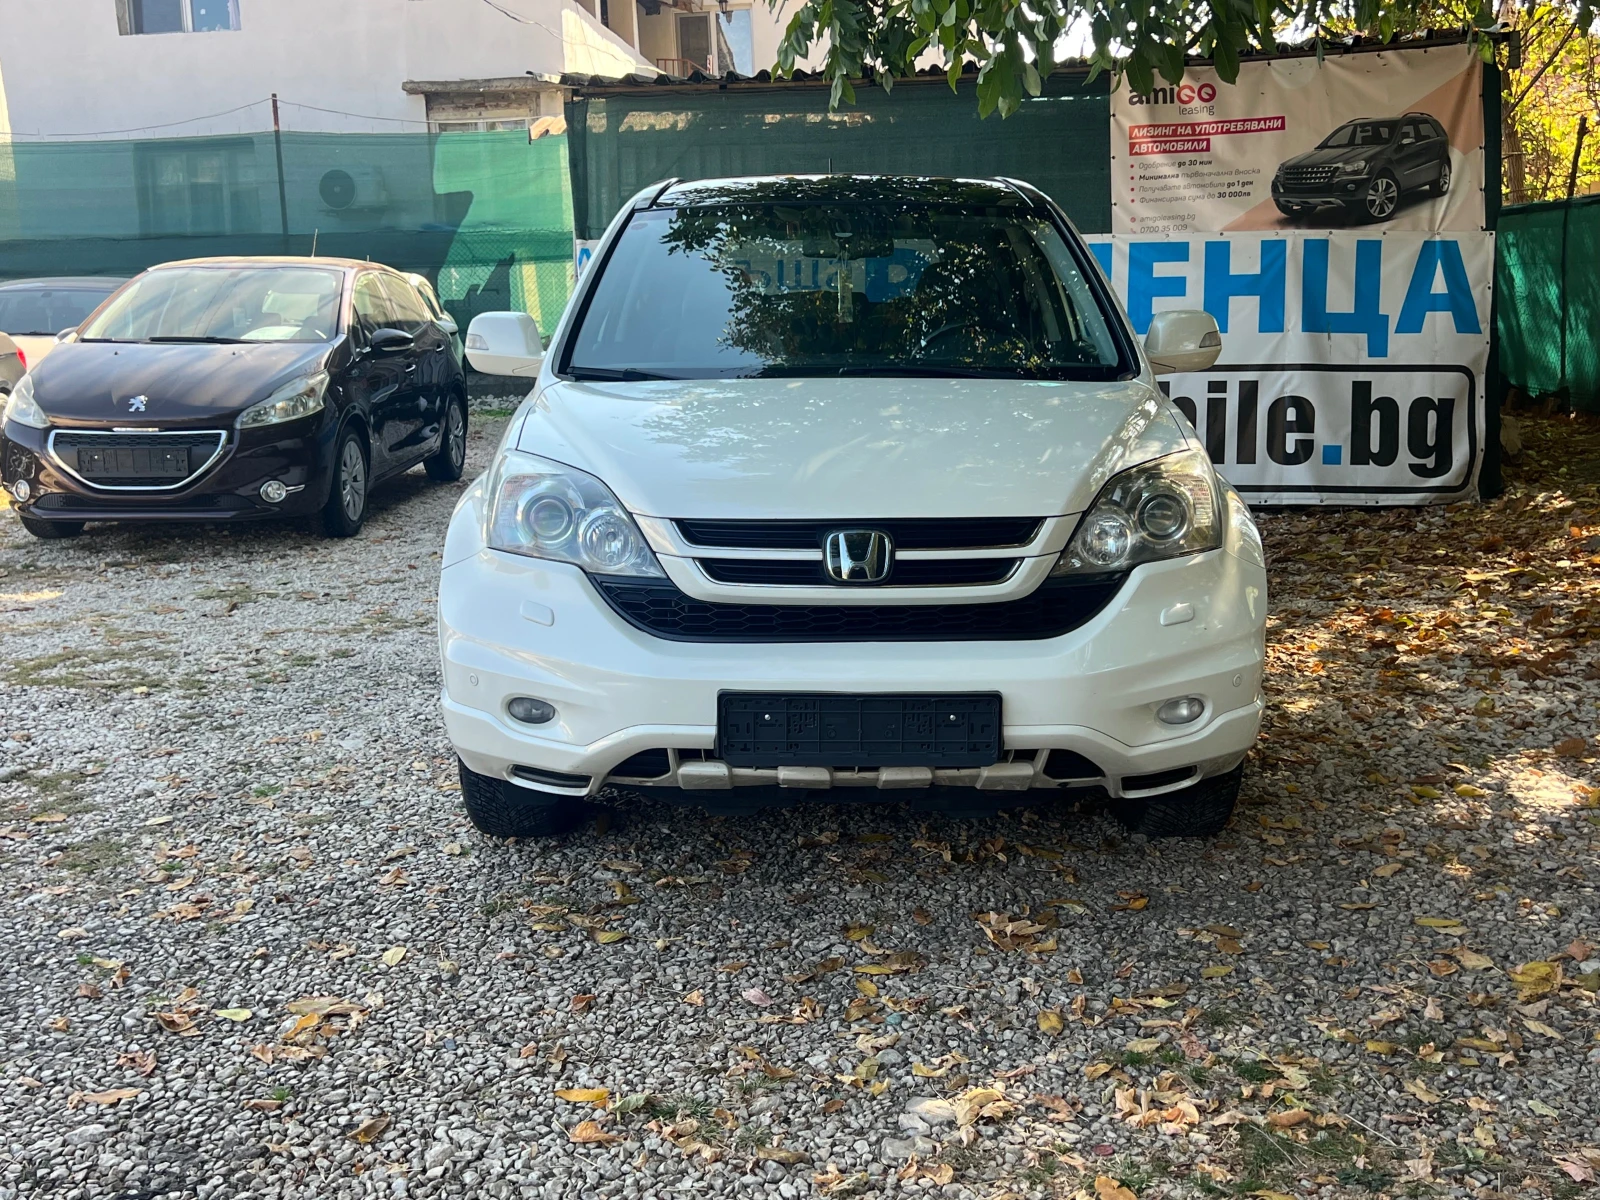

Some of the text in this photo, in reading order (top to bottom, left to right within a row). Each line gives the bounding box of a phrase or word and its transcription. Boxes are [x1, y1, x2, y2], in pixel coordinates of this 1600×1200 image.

[1178, 105, 1215, 116] leasing
[1131, 119, 1282, 138] ЛИЗИНГ НА УПОТРЕБЯВАНИ
[1131, 141, 1207, 154] АВТОМОБИЛИ
[1138, 173, 1179, 181] Минимална
[1217, 191, 1227, 199] 30
[1139, 213, 1196, 224] amigoleasing.bg
[1140, 226, 1159, 234] 0700
[1085, 239, 1483, 358] ЕНЦА
